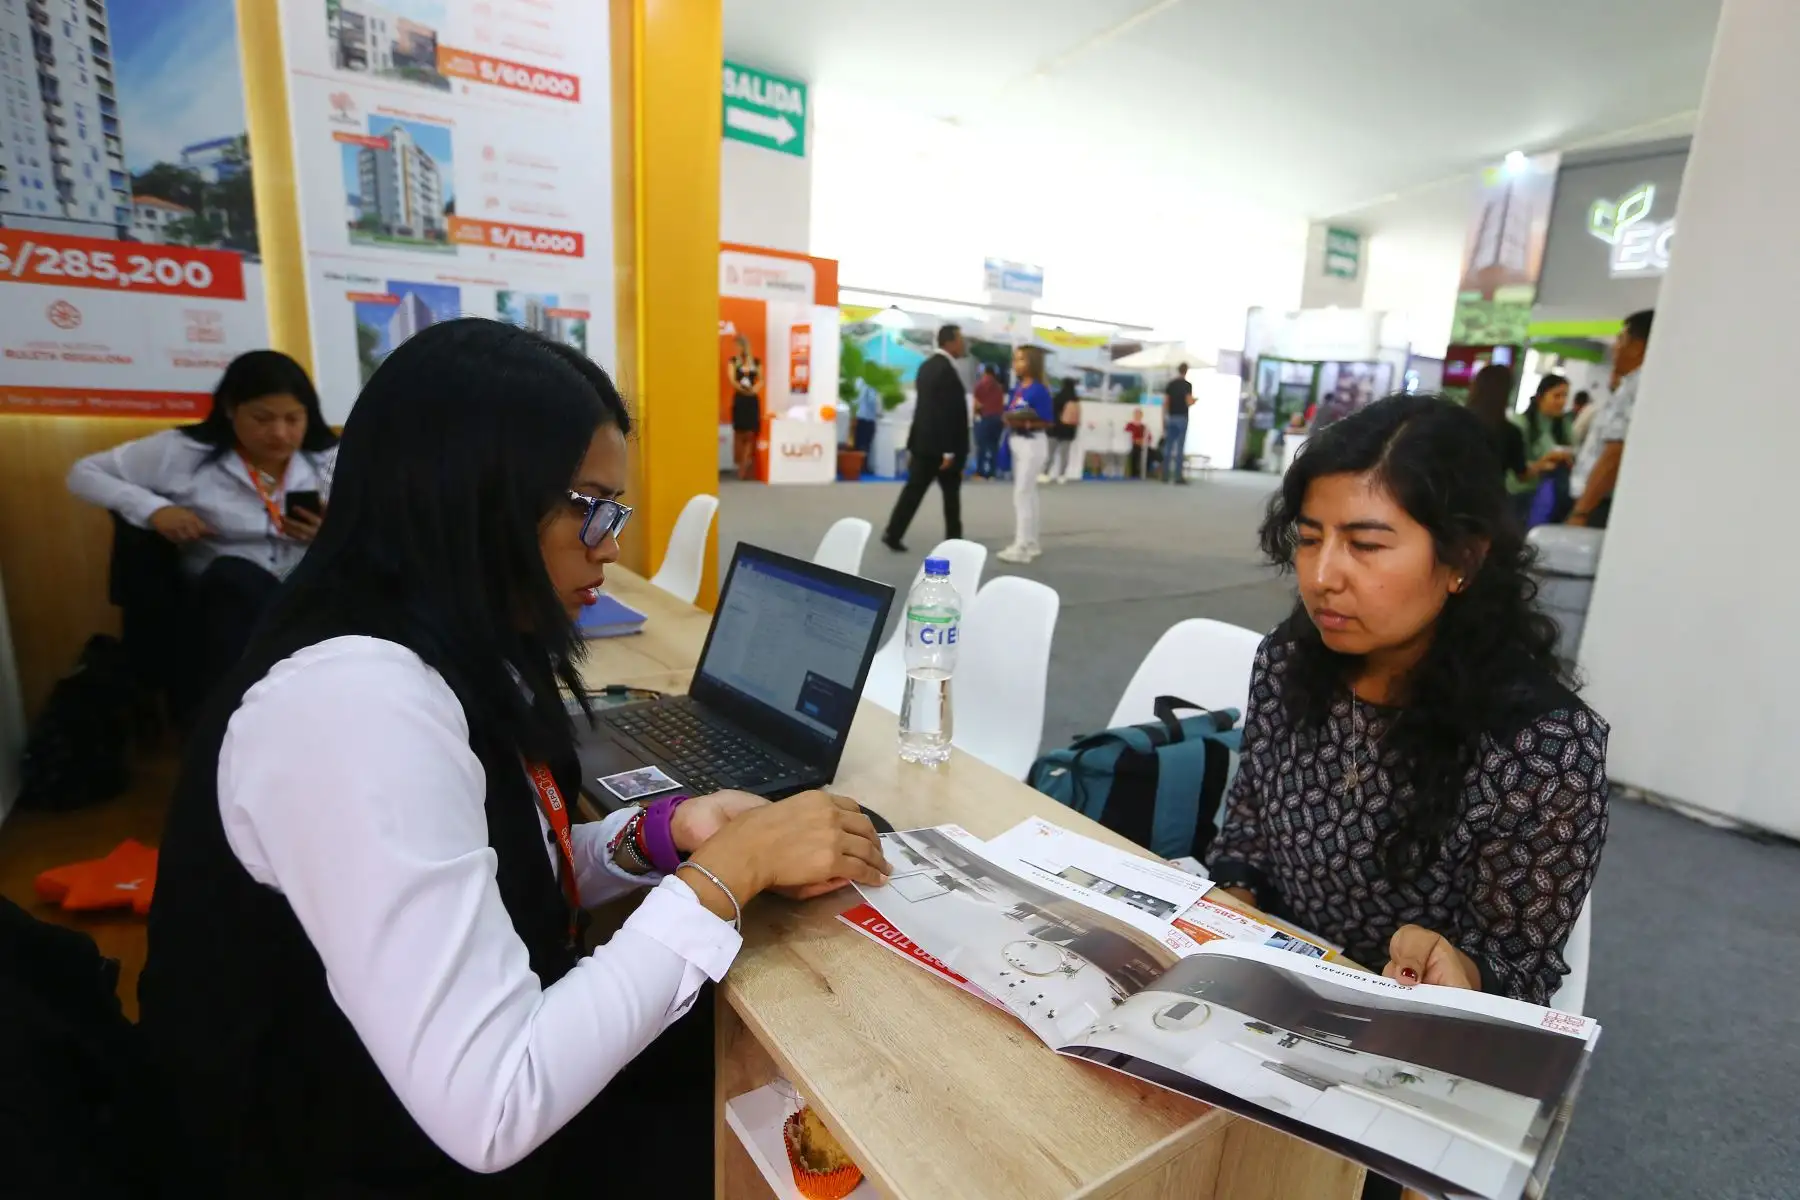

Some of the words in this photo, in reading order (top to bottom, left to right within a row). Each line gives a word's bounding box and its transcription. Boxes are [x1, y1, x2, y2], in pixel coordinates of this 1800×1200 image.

[722, 66, 804, 117] SALIDA
[919, 625, 960, 646] CIE
[548, 788, 562, 810] EXPO
[1194, 901, 1249, 925] S/285,20
[1315, 964, 1368, 982] EQUIPADA
[1372, 979, 1413, 992] COCINA
